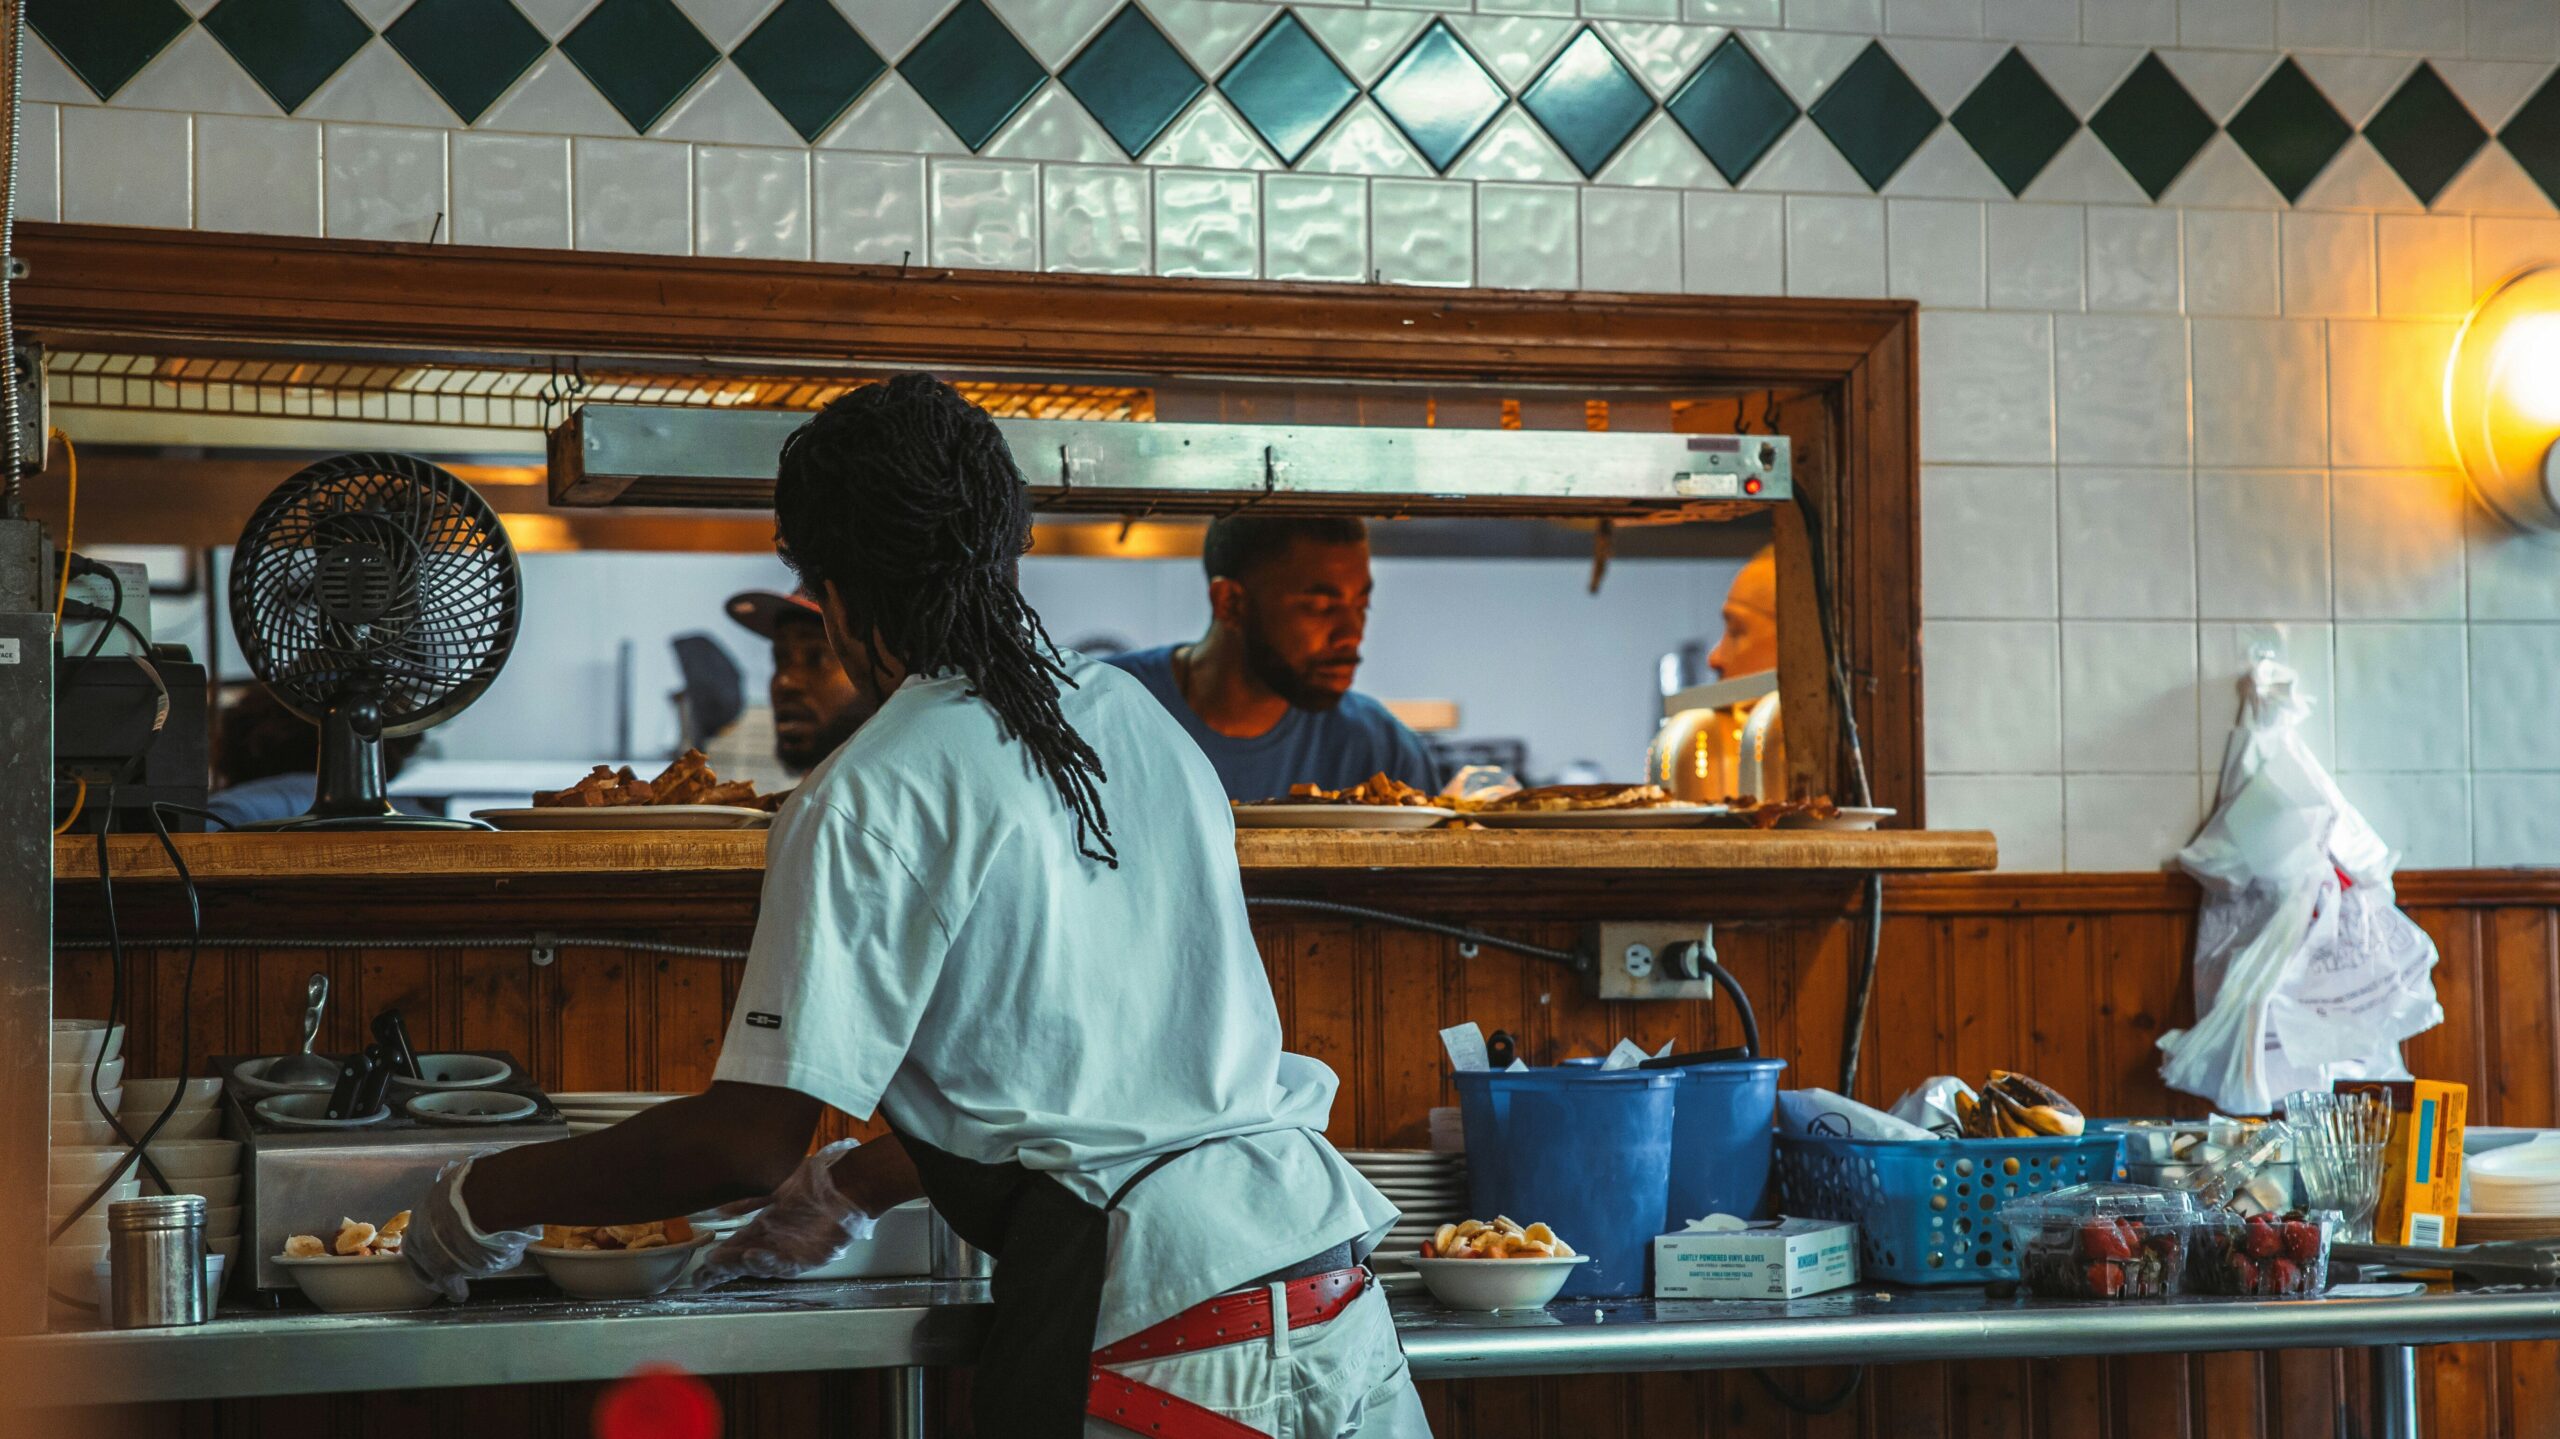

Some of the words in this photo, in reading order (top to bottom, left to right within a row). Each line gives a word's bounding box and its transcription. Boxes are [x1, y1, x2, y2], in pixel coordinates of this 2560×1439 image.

[1677, 1253, 1698, 1262] LIGHTLY
[1699, 1253, 1727, 1262] POWDERED
[1728, 1254, 1744, 1262] VINYL
[1744, 1254, 1765, 1263] GLOVES
